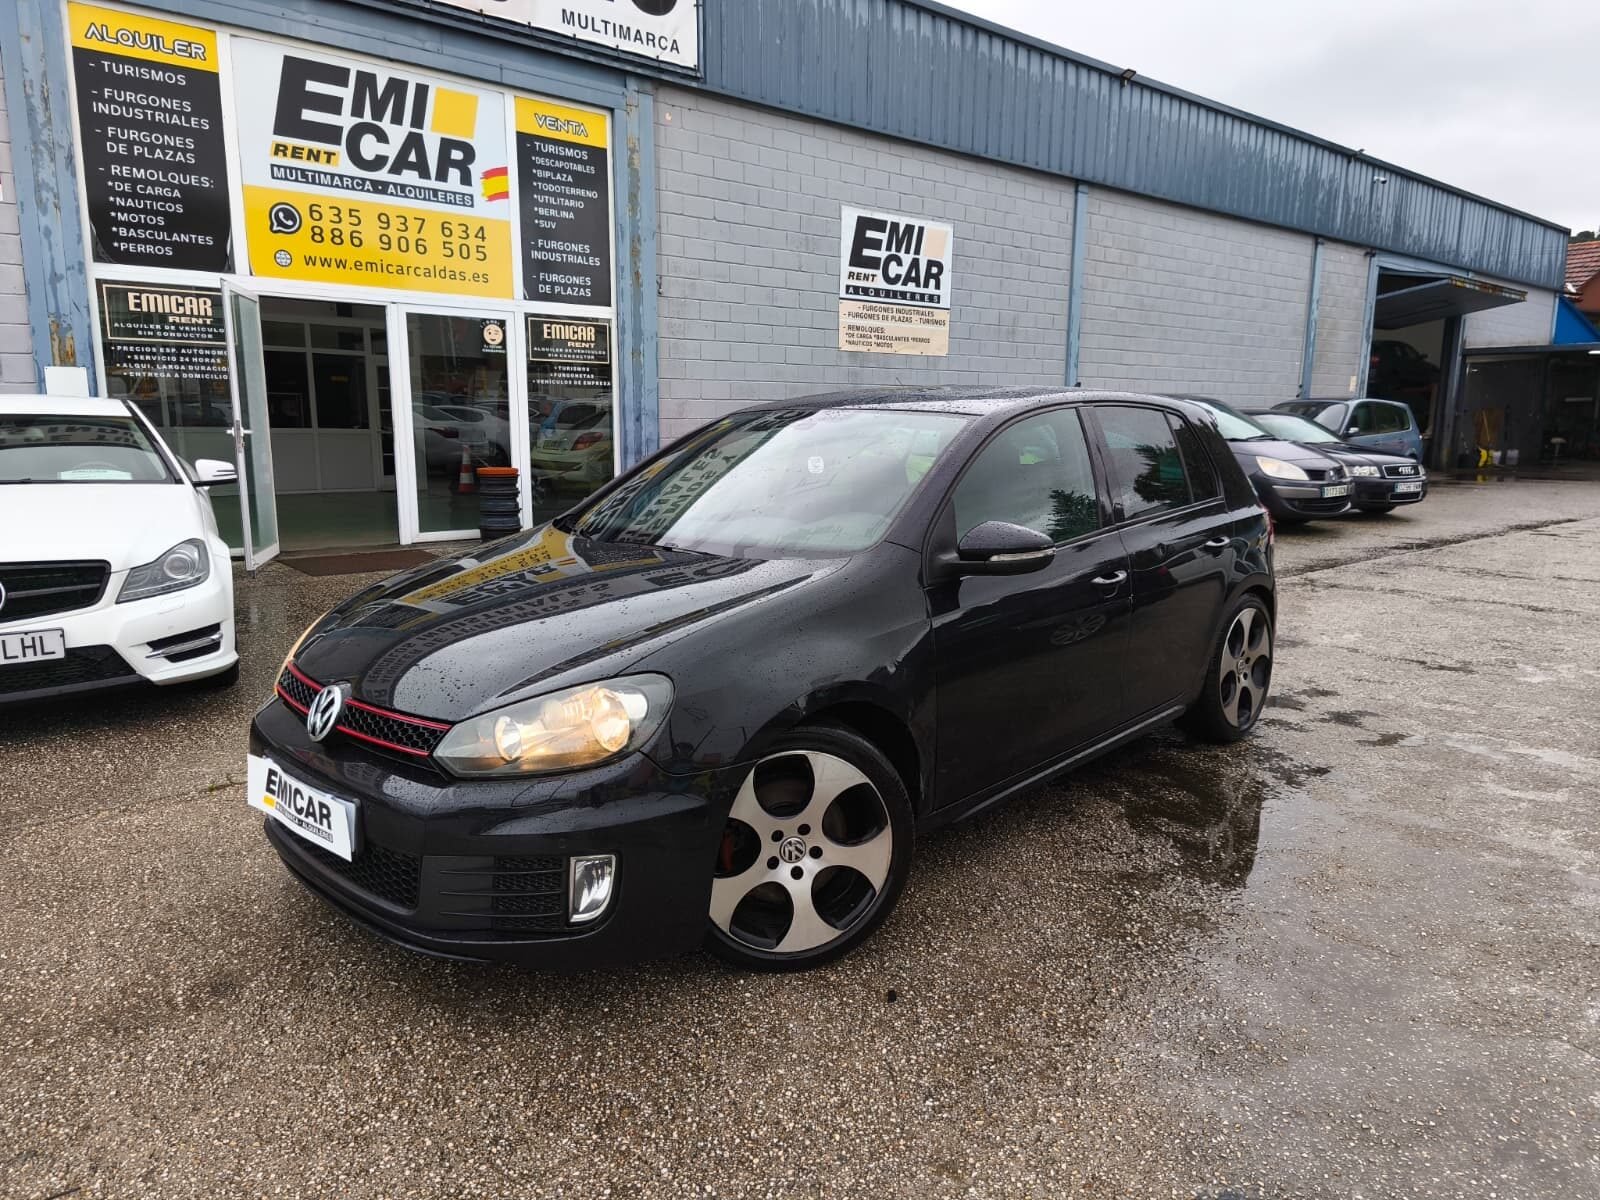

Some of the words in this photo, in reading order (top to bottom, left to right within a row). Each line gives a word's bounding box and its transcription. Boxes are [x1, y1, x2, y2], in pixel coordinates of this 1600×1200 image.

[85, 22, 207, 61] ALQUILER
[562, 8, 681, 54] MULTIMARCA
[101, 60, 187, 85] TURISMOS
[104, 88, 192, 112] FURGONES
[92, 101, 210, 130] INDUSTRIALES
[534, 112, 589, 137] VENTA
[107, 127, 194, 149] FURGONES
[106, 142, 127, 155] DE
[133, 145, 196, 164] PLAZAS
[273, 143, 337, 165] RENT
[534, 141, 589, 160] TURISMOS
[111, 165, 215, 188] REMOLQUES:
[273, 166, 373, 192] MULTIMARCA
[387, 185, 473, 207] ALQUILERES
[136, 184, 181, 198] CARGA
[308, 203, 362, 227] 635
[377, 212, 426, 234] 937
[440, 220, 487, 242] 634
[310, 226, 364, 248] 886
[379, 233, 428, 255] 906
[442, 241, 488, 262] 505
[537, 239, 590, 254] FURGONES
[303, 254, 489, 283] www.emicarcaldas.es
[531, 250, 600, 266] INDUSTRIALES
[539, 272, 591, 286] FURGONES
[848, 271, 877, 282] RENT
[538, 284, 552, 294] DE
[555, 285, 591, 297] PLAZAS
[849, 286, 938, 302] ALQUILERES
[127, 292, 213, 316] EMICAR
[862, 304, 894, 314] FURGONES
[896, 307, 934, 317] INDUSTRIALES
[114, 322, 161, 330] ALQUILER
[168, 316, 213, 324] RENT
[891, 315, 913, 323] PLAZAS
[919, 318, 946, 326] TURISMOS
[543, 324, 595, 341] EMICAR
[133, 354, 176, 362] SERVICIO
[2, 635, 56, 660] LHL
[265, 768, 333, 831] EMICAR
